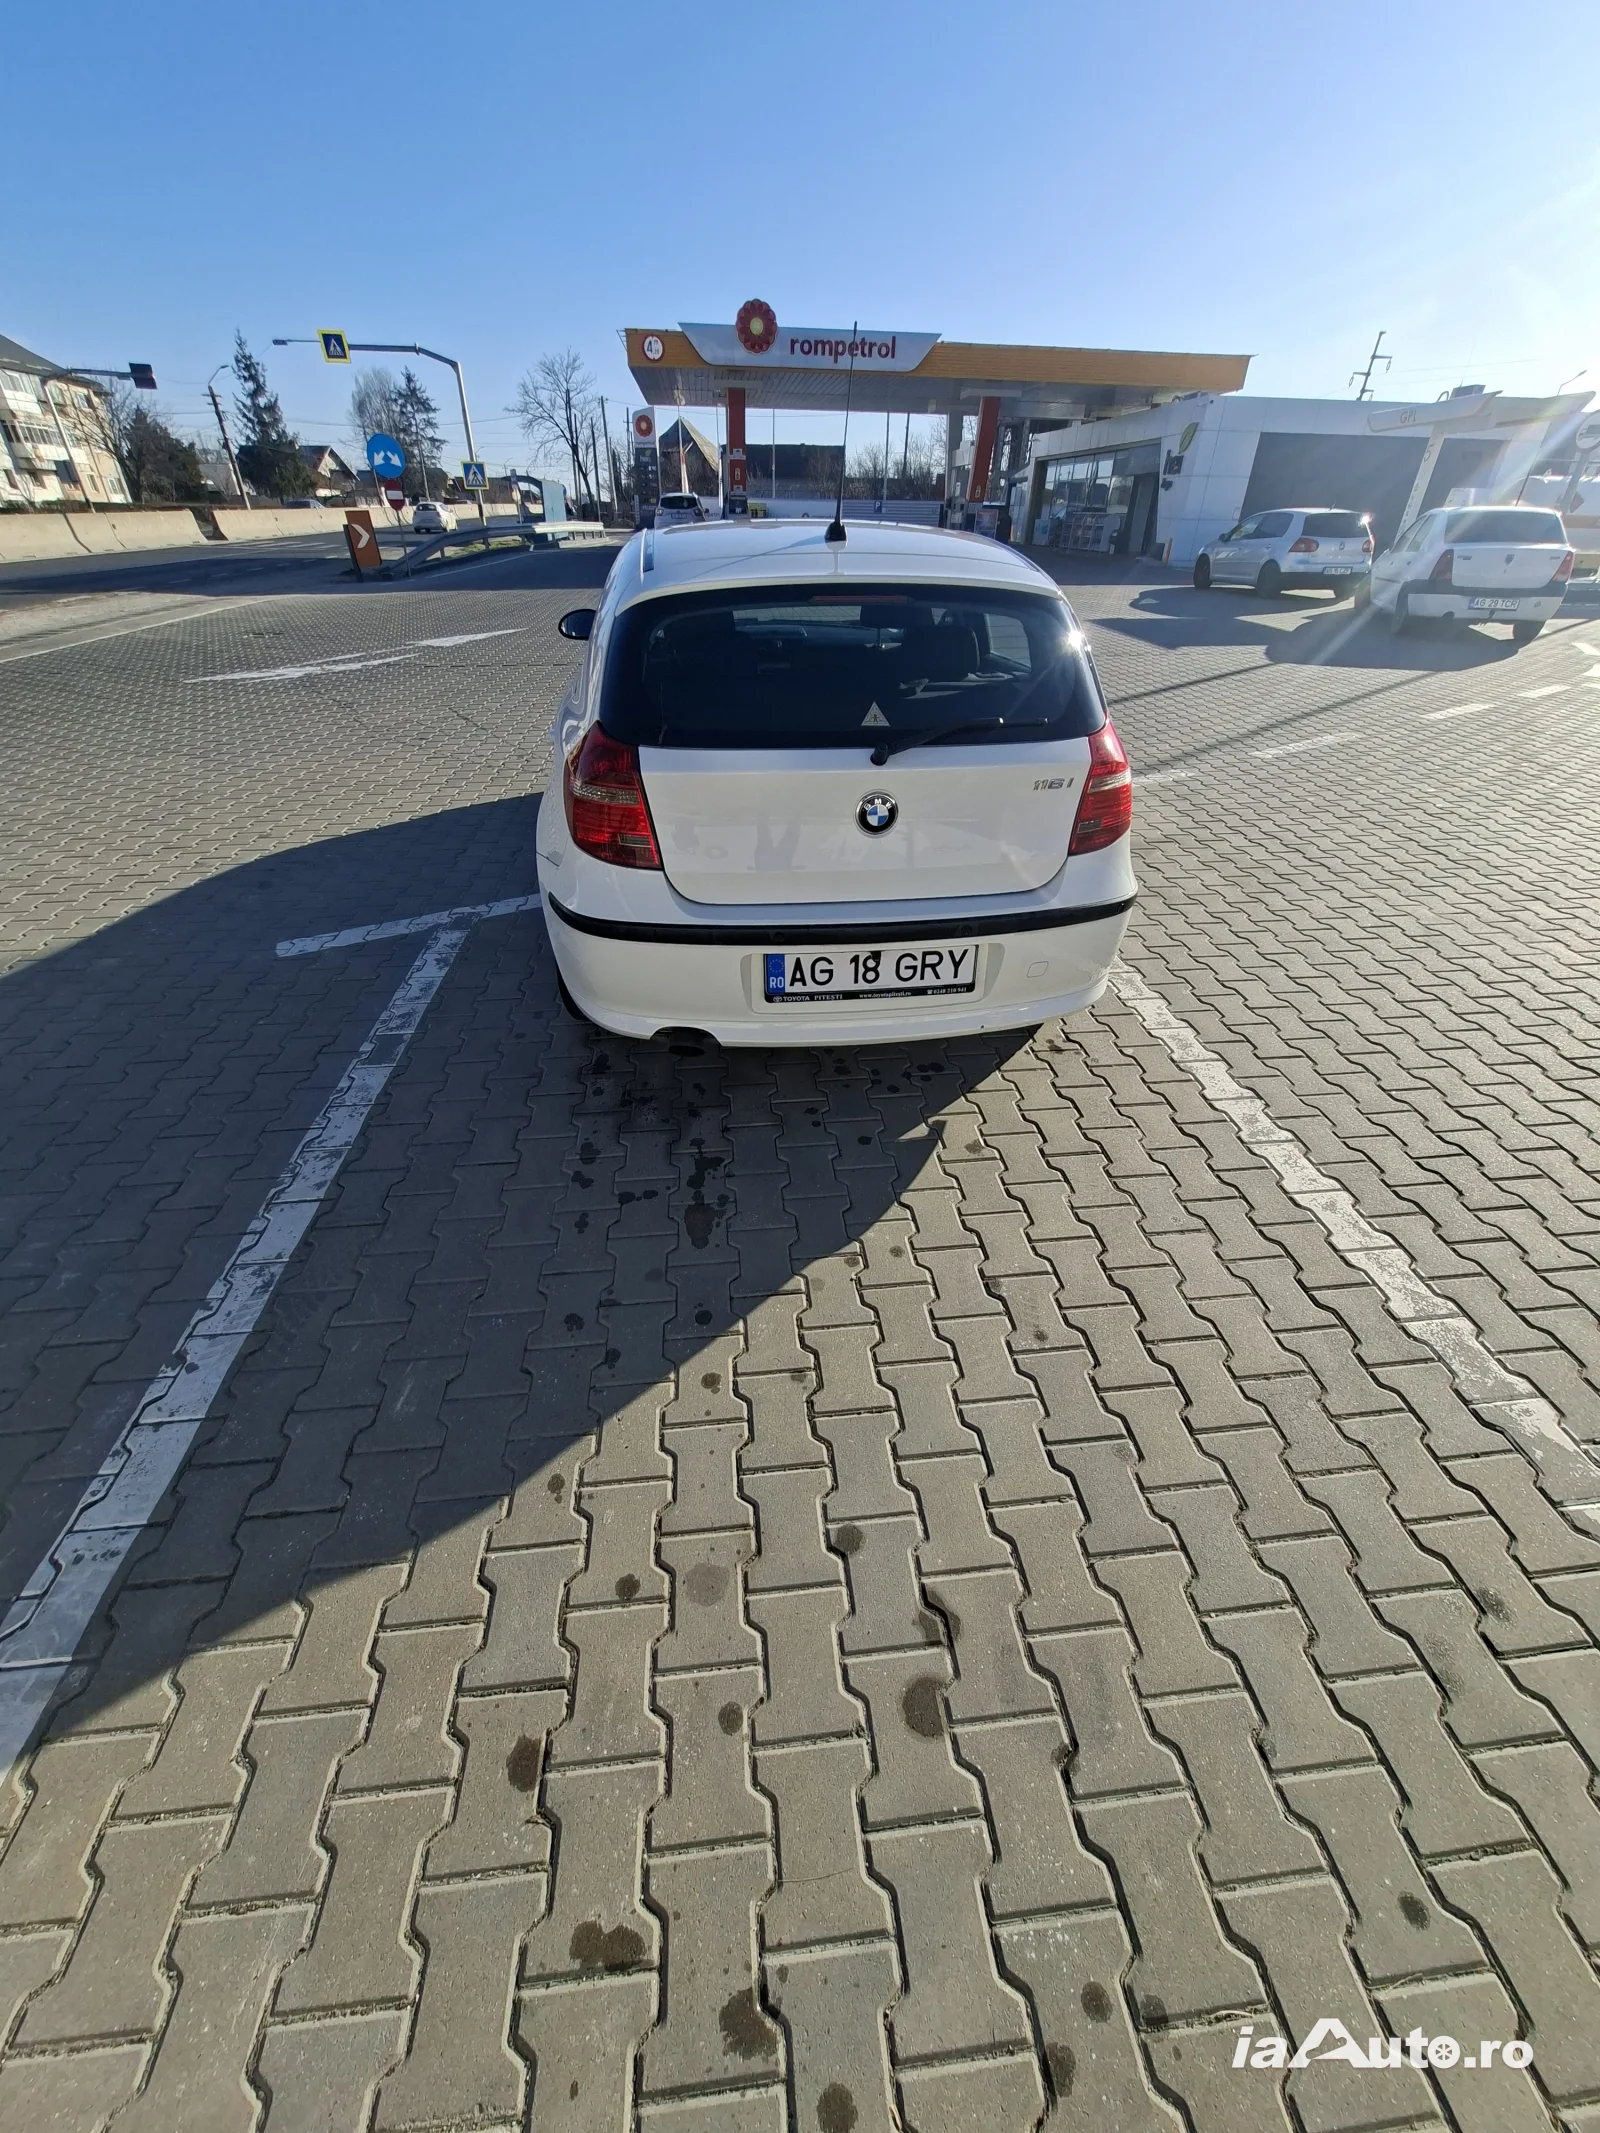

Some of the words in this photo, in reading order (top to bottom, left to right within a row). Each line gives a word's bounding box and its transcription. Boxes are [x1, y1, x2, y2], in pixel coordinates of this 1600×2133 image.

[790, 336, 896, 364] rompetrol
[1474, 598, 1486, 607] AG
[1487, 599, 1499, 608] 29
[1500, 600, 1517, 608] TCR
[863, 798, 893, 811] BMW
[789, 957, 834, 986] AG
[849, 954, 881, 984] 18
[895, 949, 969, 983] GRY
[769, 977, 784, 988] RO
